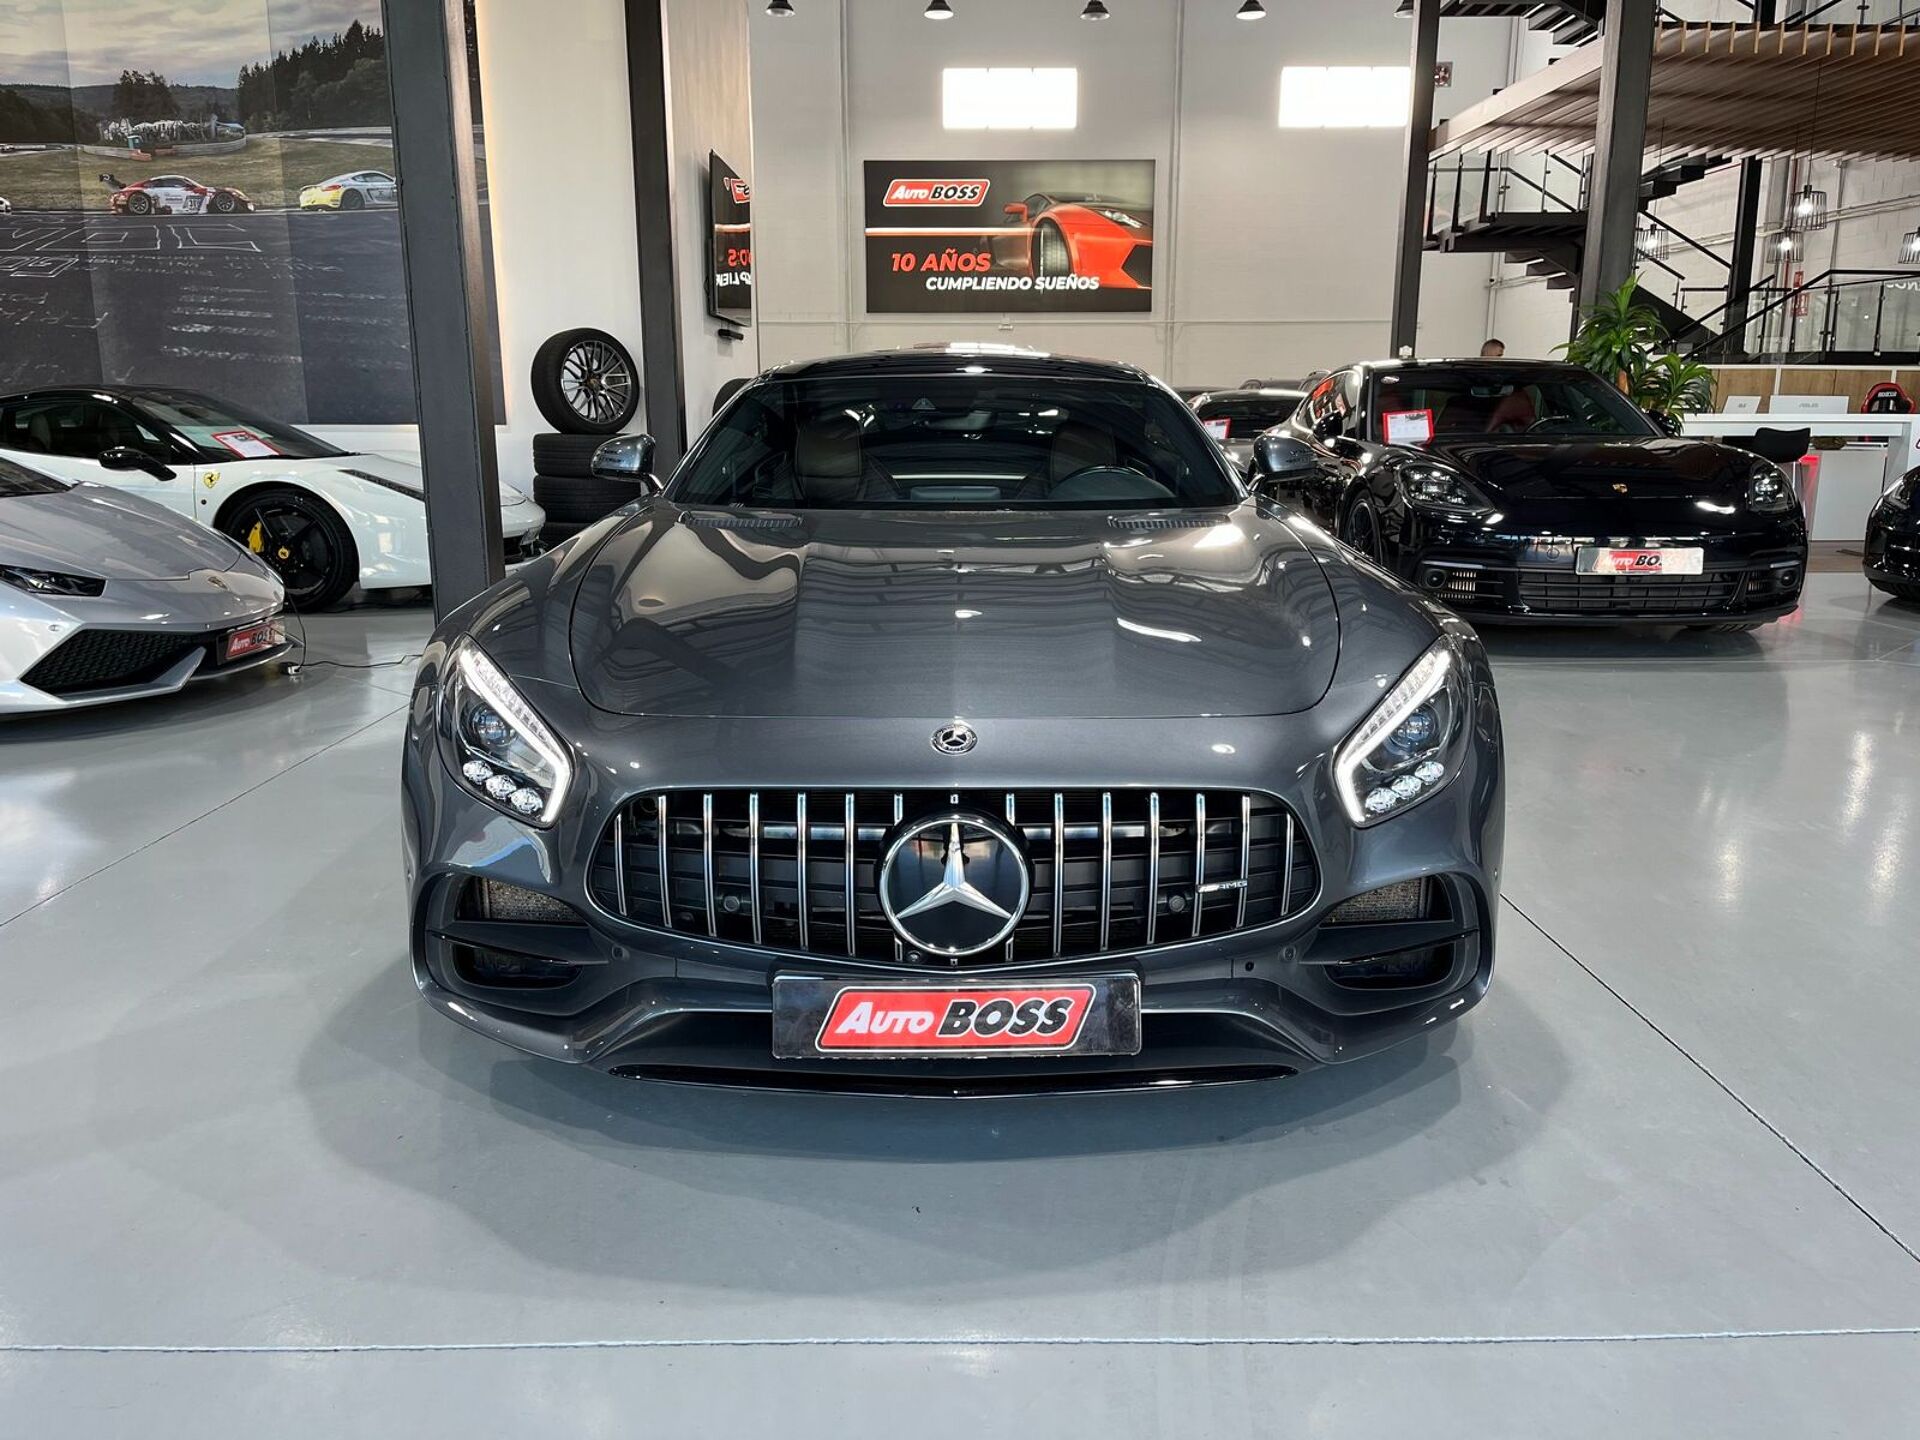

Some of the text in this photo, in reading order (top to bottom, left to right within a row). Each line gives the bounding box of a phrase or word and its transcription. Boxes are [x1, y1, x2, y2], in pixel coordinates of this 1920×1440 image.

[931, 184, 981, 200] BOSS
[892, 248, 991, 271] 10 AÑOS
[926, 273, 1100, 290] CUMPLIENDO SUEÑOS
[936, 997, 1075, 1038] BOSS
